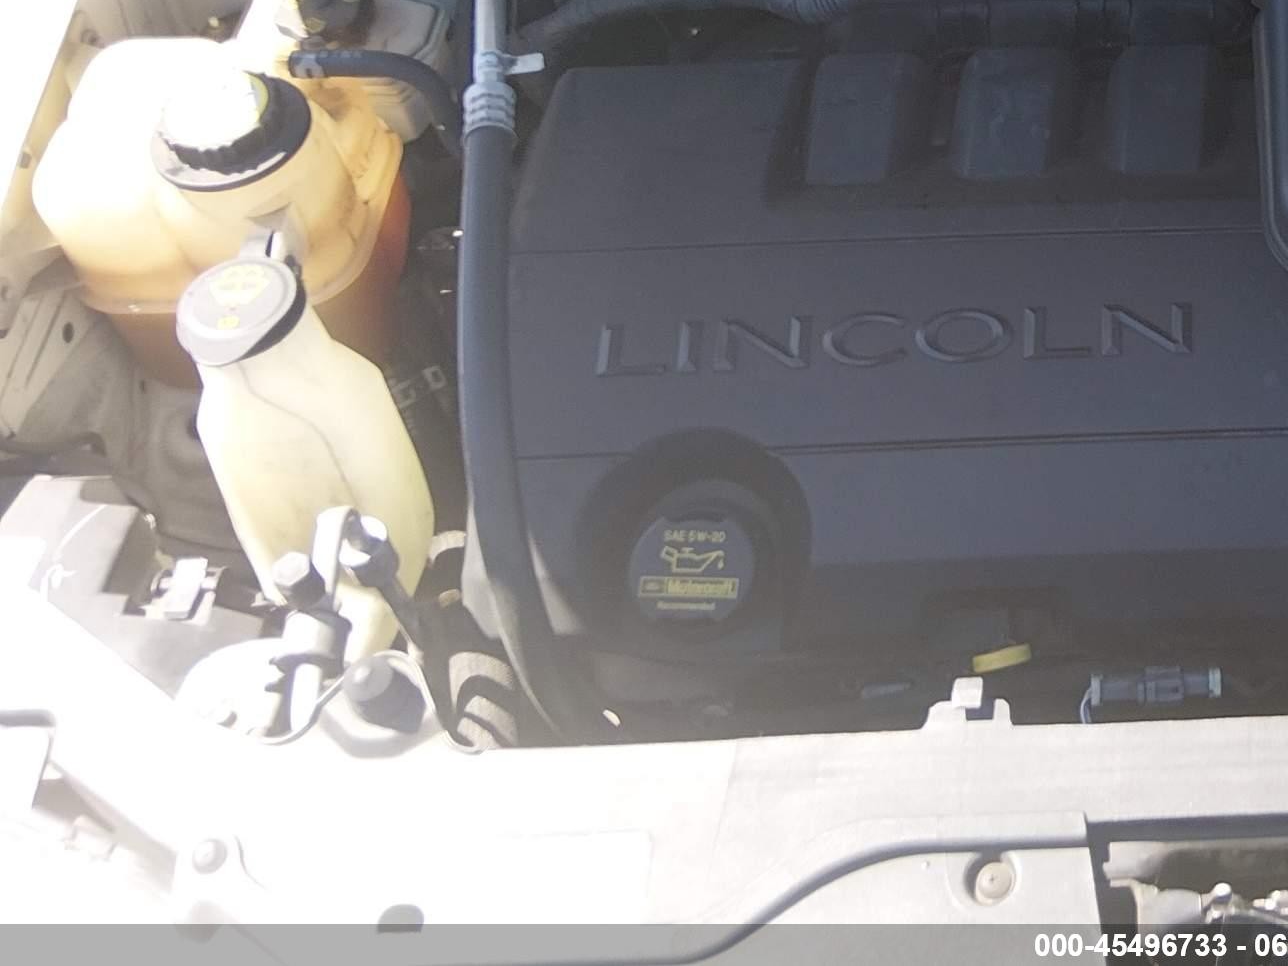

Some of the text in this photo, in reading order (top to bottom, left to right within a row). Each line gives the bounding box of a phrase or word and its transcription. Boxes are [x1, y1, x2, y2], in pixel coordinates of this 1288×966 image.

[594, 303, 1193, 376] LINCOLN
[664, 529, 726, 543] SAE 5W-20
[667, 578, 737, 595] Motorcraft
